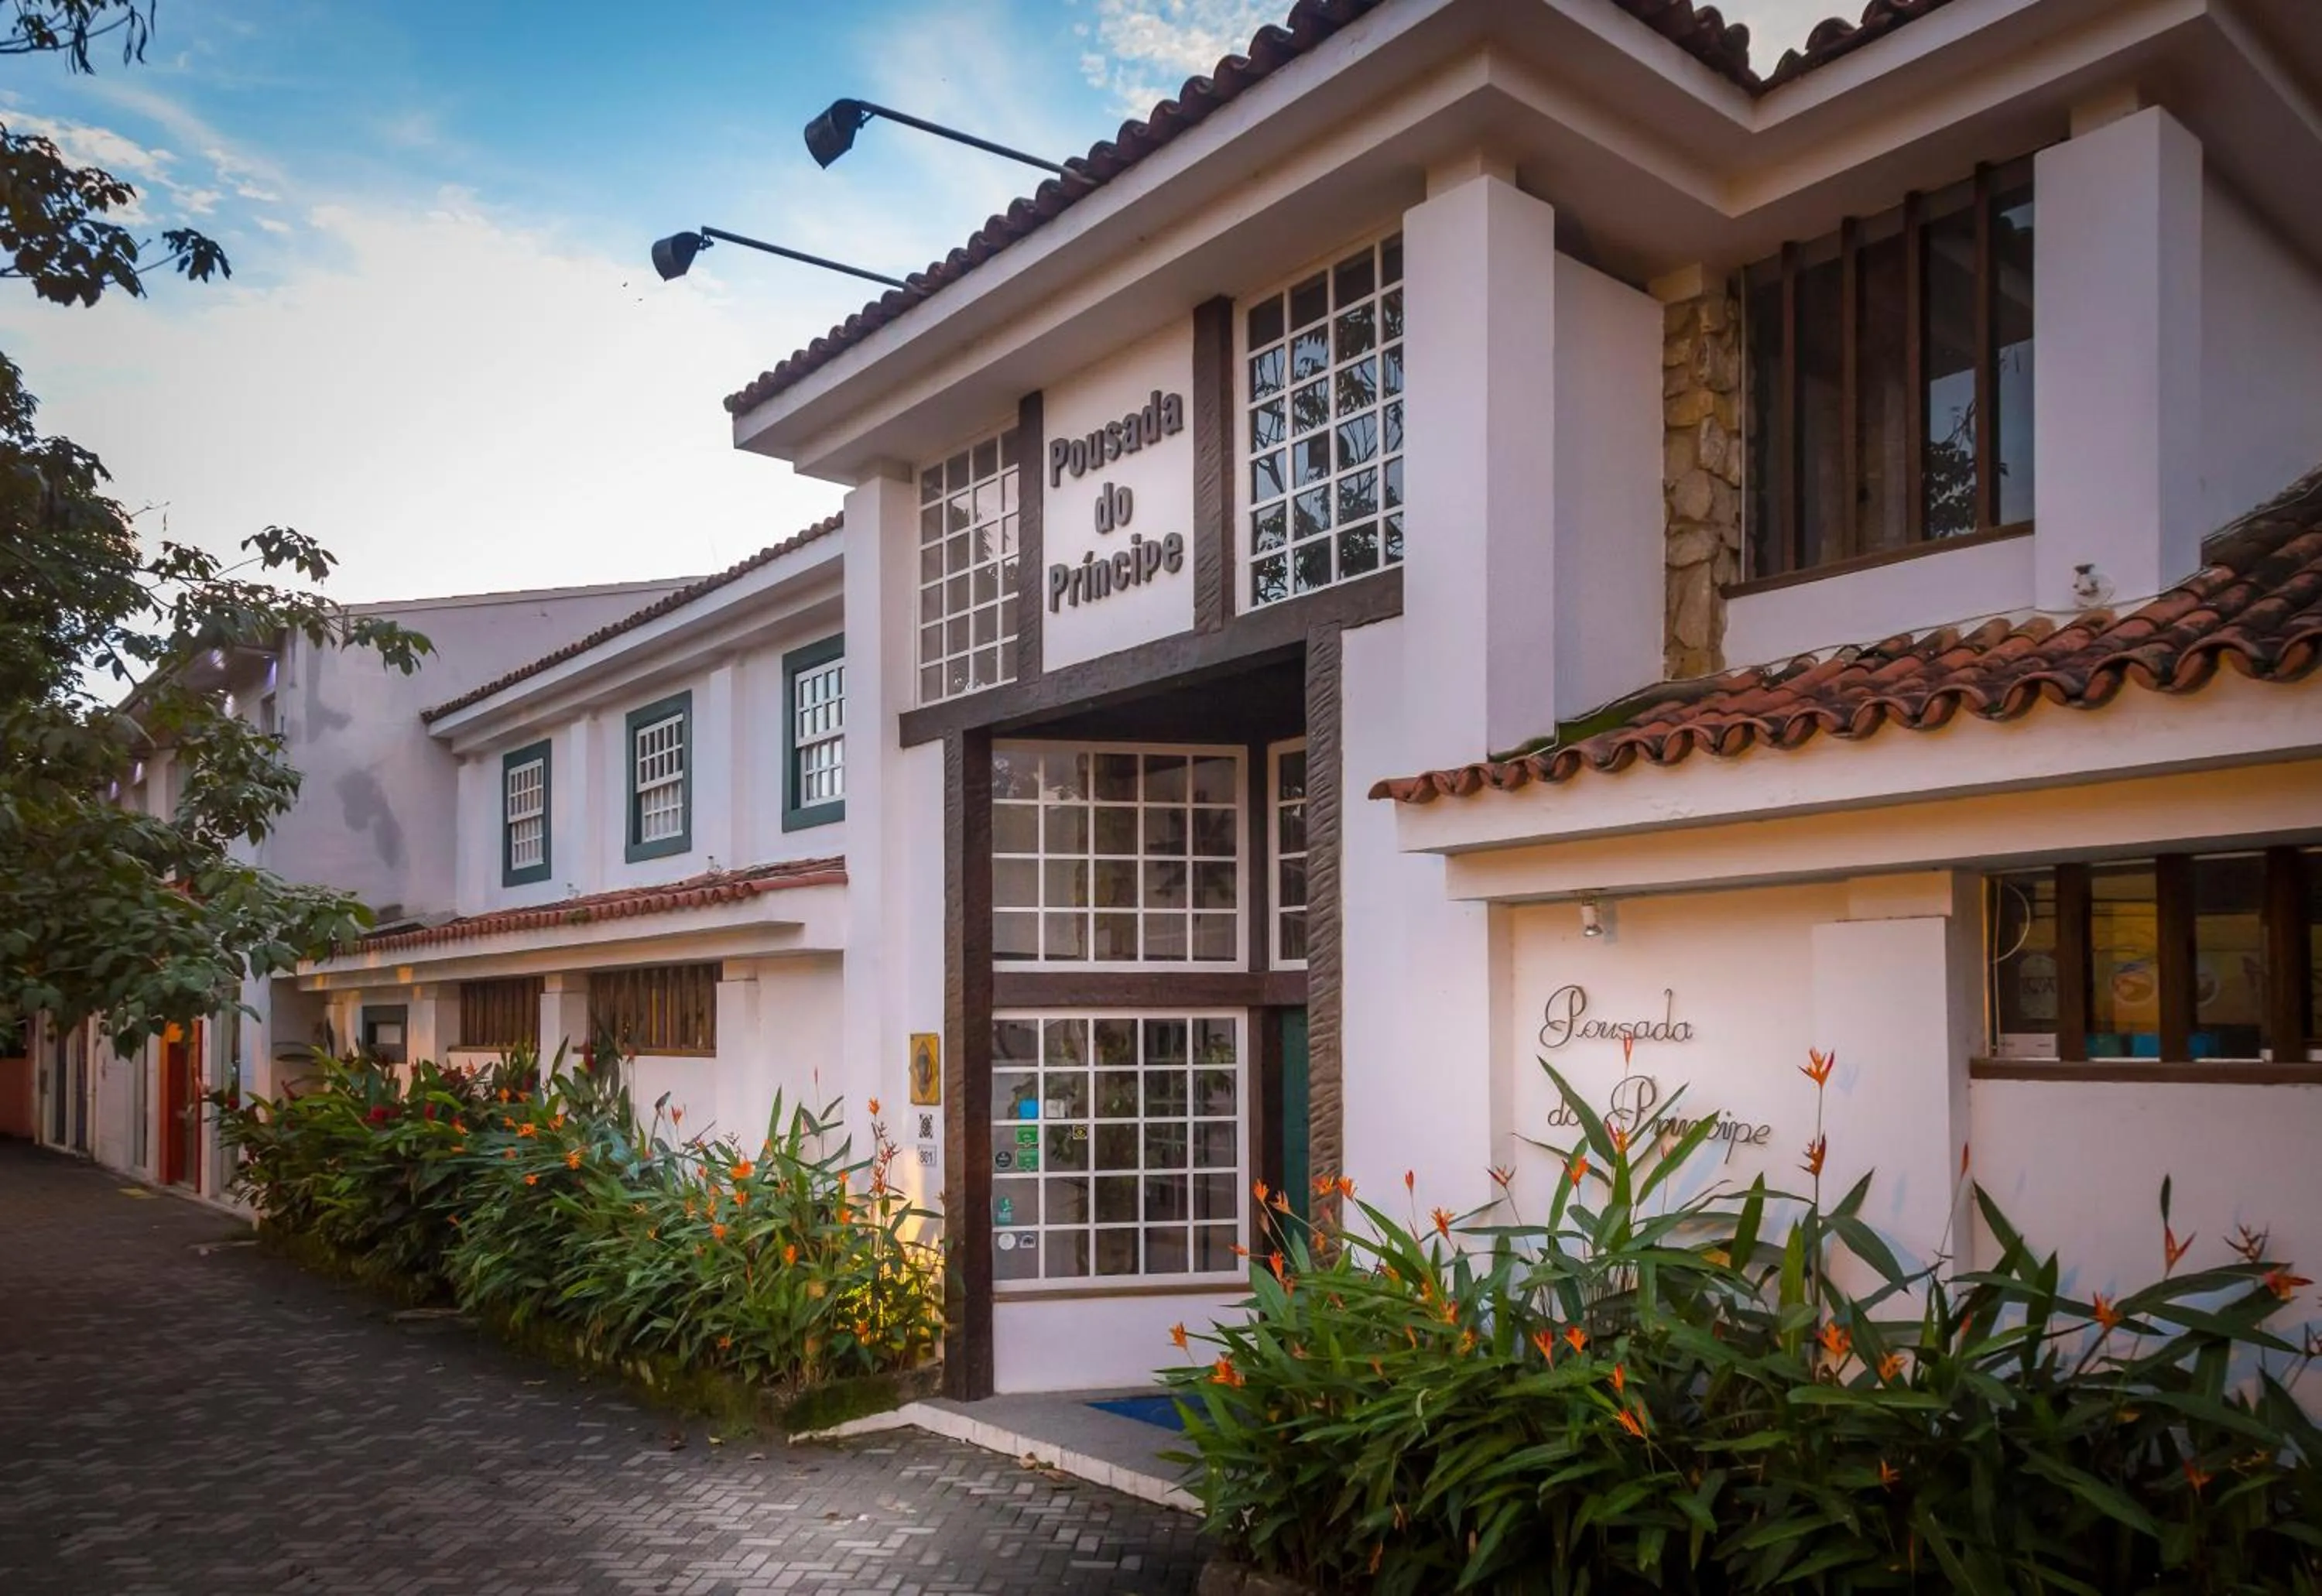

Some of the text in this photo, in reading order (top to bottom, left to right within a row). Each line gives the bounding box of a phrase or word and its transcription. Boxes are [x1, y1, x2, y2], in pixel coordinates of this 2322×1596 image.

[1049, 389, 1184, 488] Pousada
[1094, 481, 1133, 534] do
[1048, 532, 1183, 614] Príncipe
[1539, 985, 1693, 1049] Pousada
[1548, 1090, 1581, 1126] do
